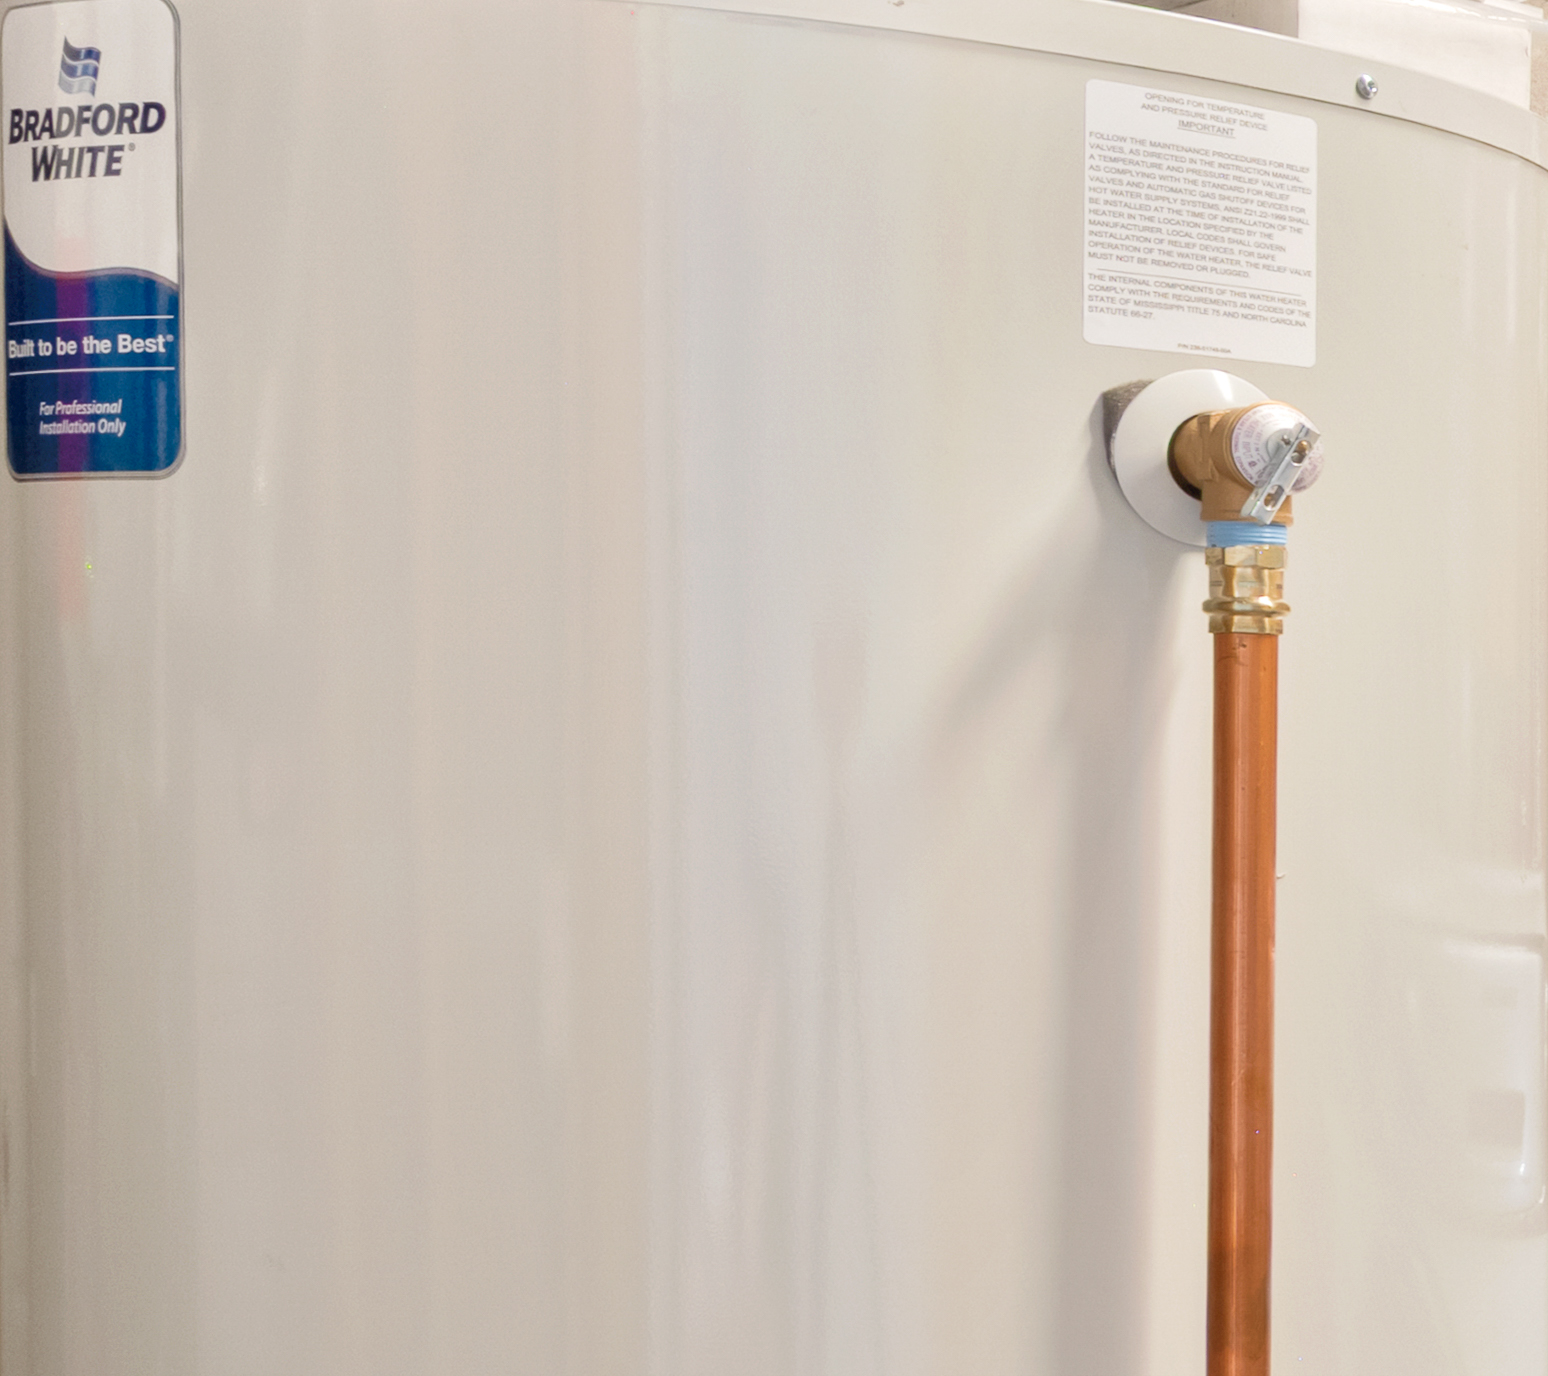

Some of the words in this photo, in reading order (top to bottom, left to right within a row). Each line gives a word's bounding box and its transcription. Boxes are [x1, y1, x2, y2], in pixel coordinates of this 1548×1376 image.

[8, 101, 166, 144] BRADFORD
[32, 144, 125, 182] WHITE
[8, 339, 34, 358] Built
[38, 339, 52, 356] to
[57, 337, 77, 355] be
[82, 335, 111, 354] the
[40, 402, 55, 415] For
[55, 399, 122, 415] Professional
[40, 420, 95, 435] Installation
[98, 418, 126, 437] Only
